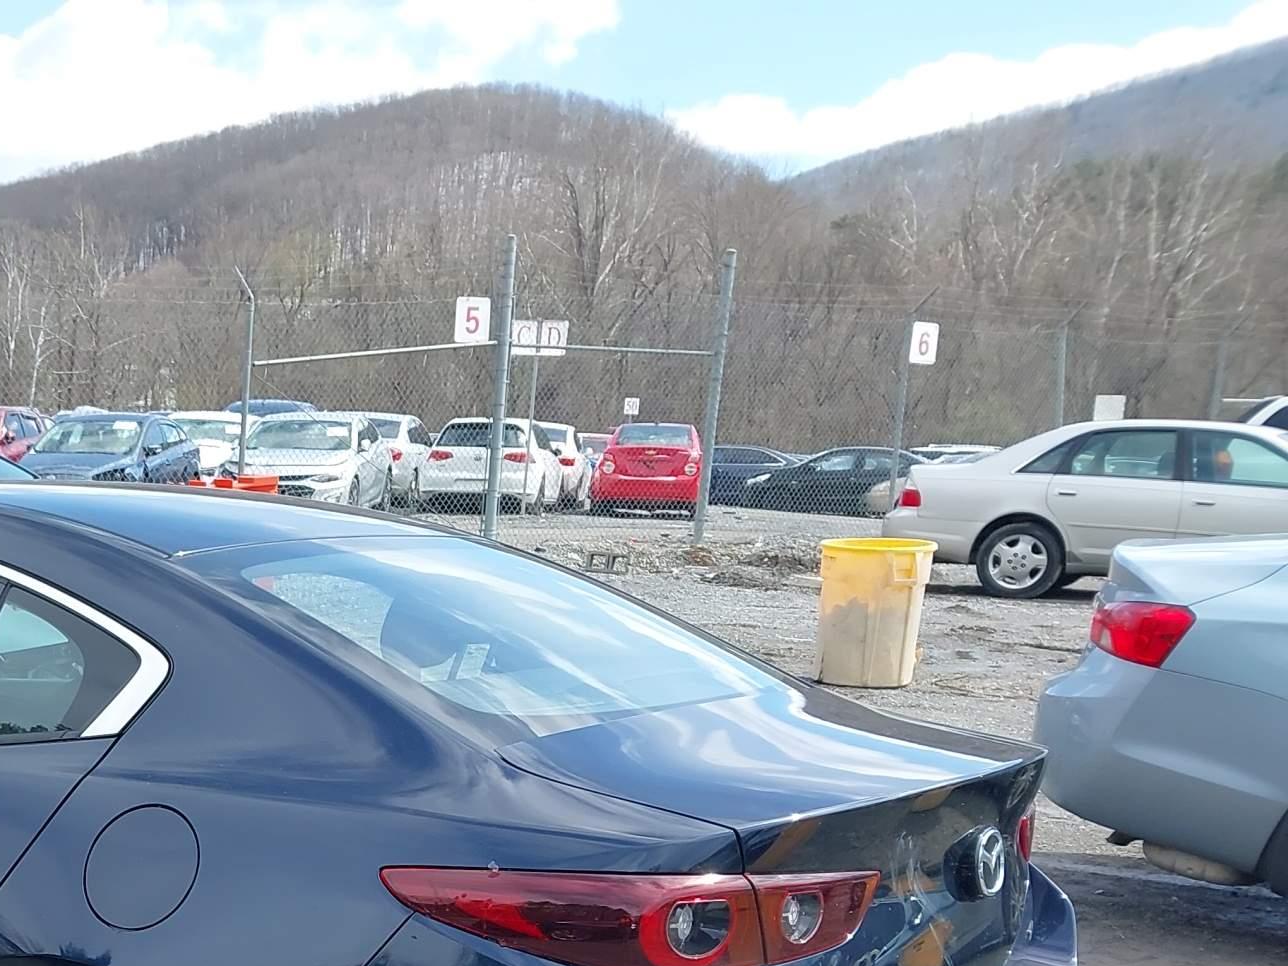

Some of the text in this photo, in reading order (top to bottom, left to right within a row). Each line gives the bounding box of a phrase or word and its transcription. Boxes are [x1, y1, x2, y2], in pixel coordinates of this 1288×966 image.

[465, 306, 480, 334] 5
[517, 325, 561, 346] C D
[918, 332, 930, 356] 6
